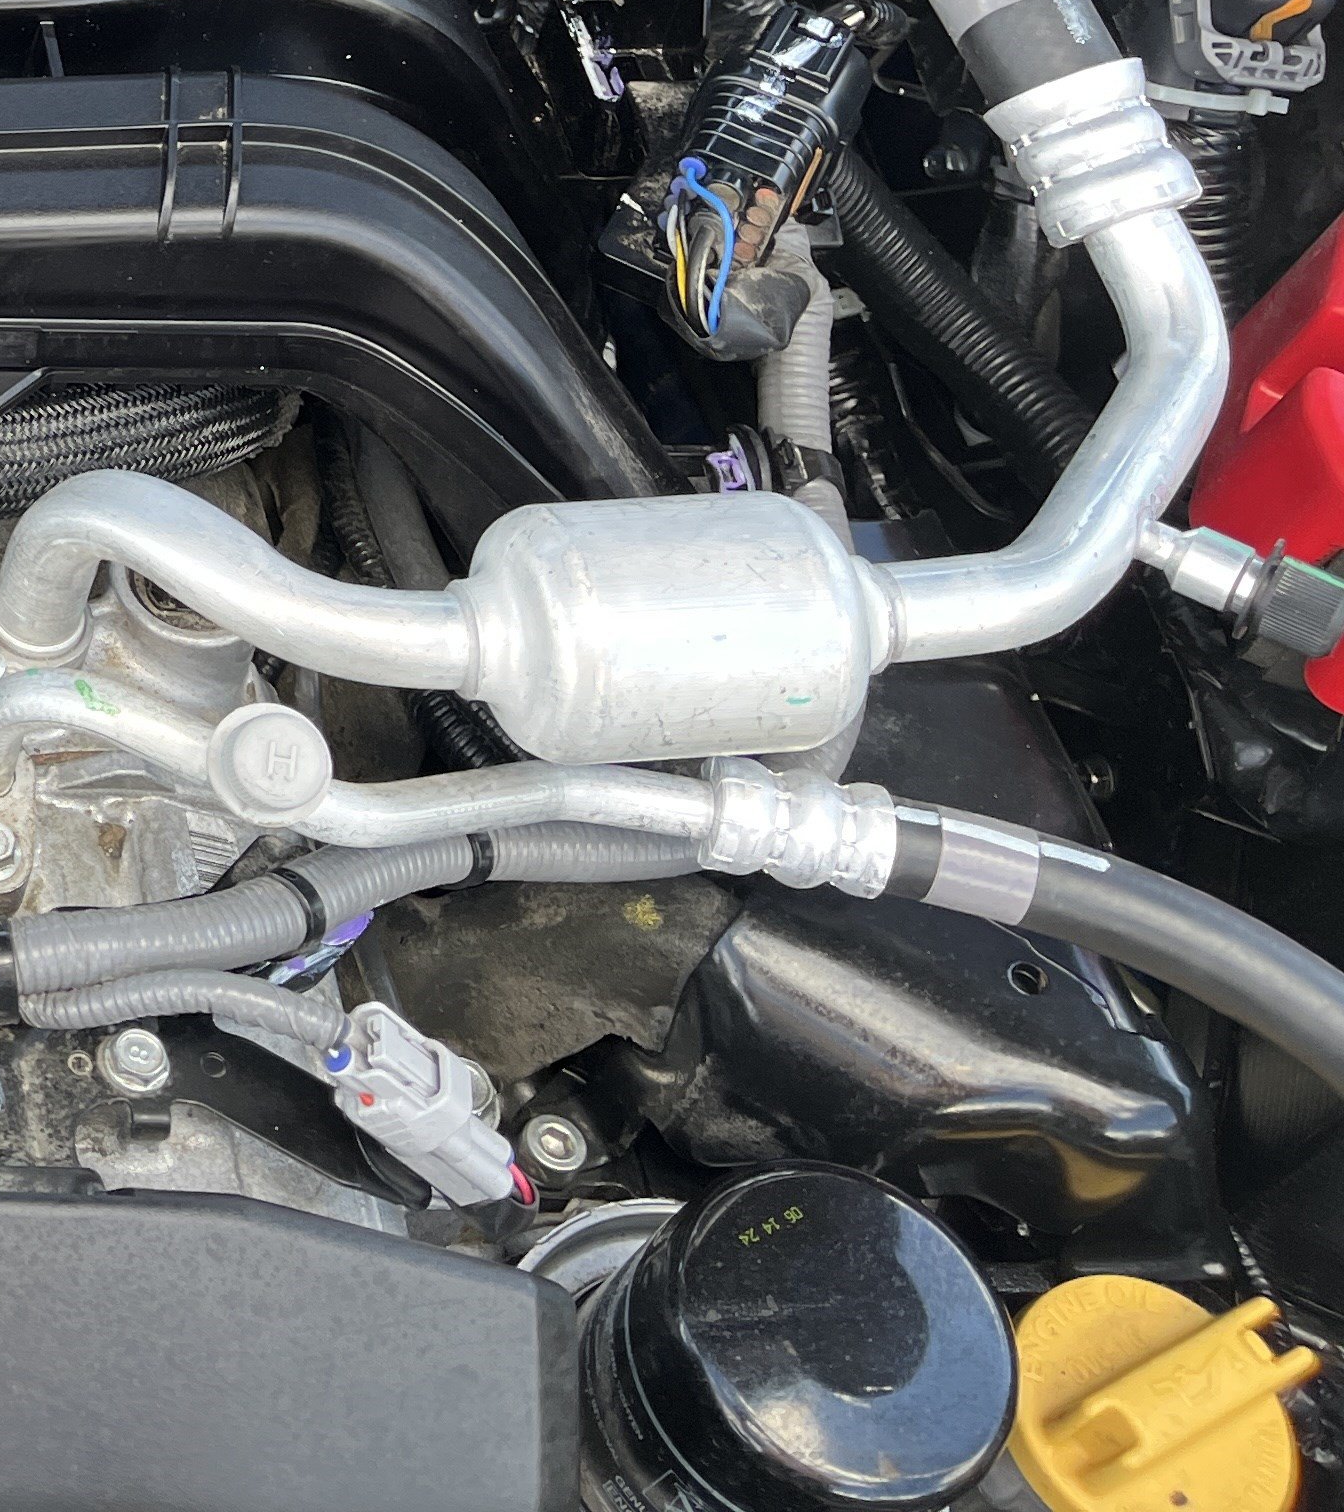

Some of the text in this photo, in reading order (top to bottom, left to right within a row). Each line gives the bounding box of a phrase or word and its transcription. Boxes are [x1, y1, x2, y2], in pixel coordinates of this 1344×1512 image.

[783, 1206, 804, 1224] 06
[761, 1216, 780, 1235] 14
[1022, 1278, 1169, 1384] ENGINE OIL
